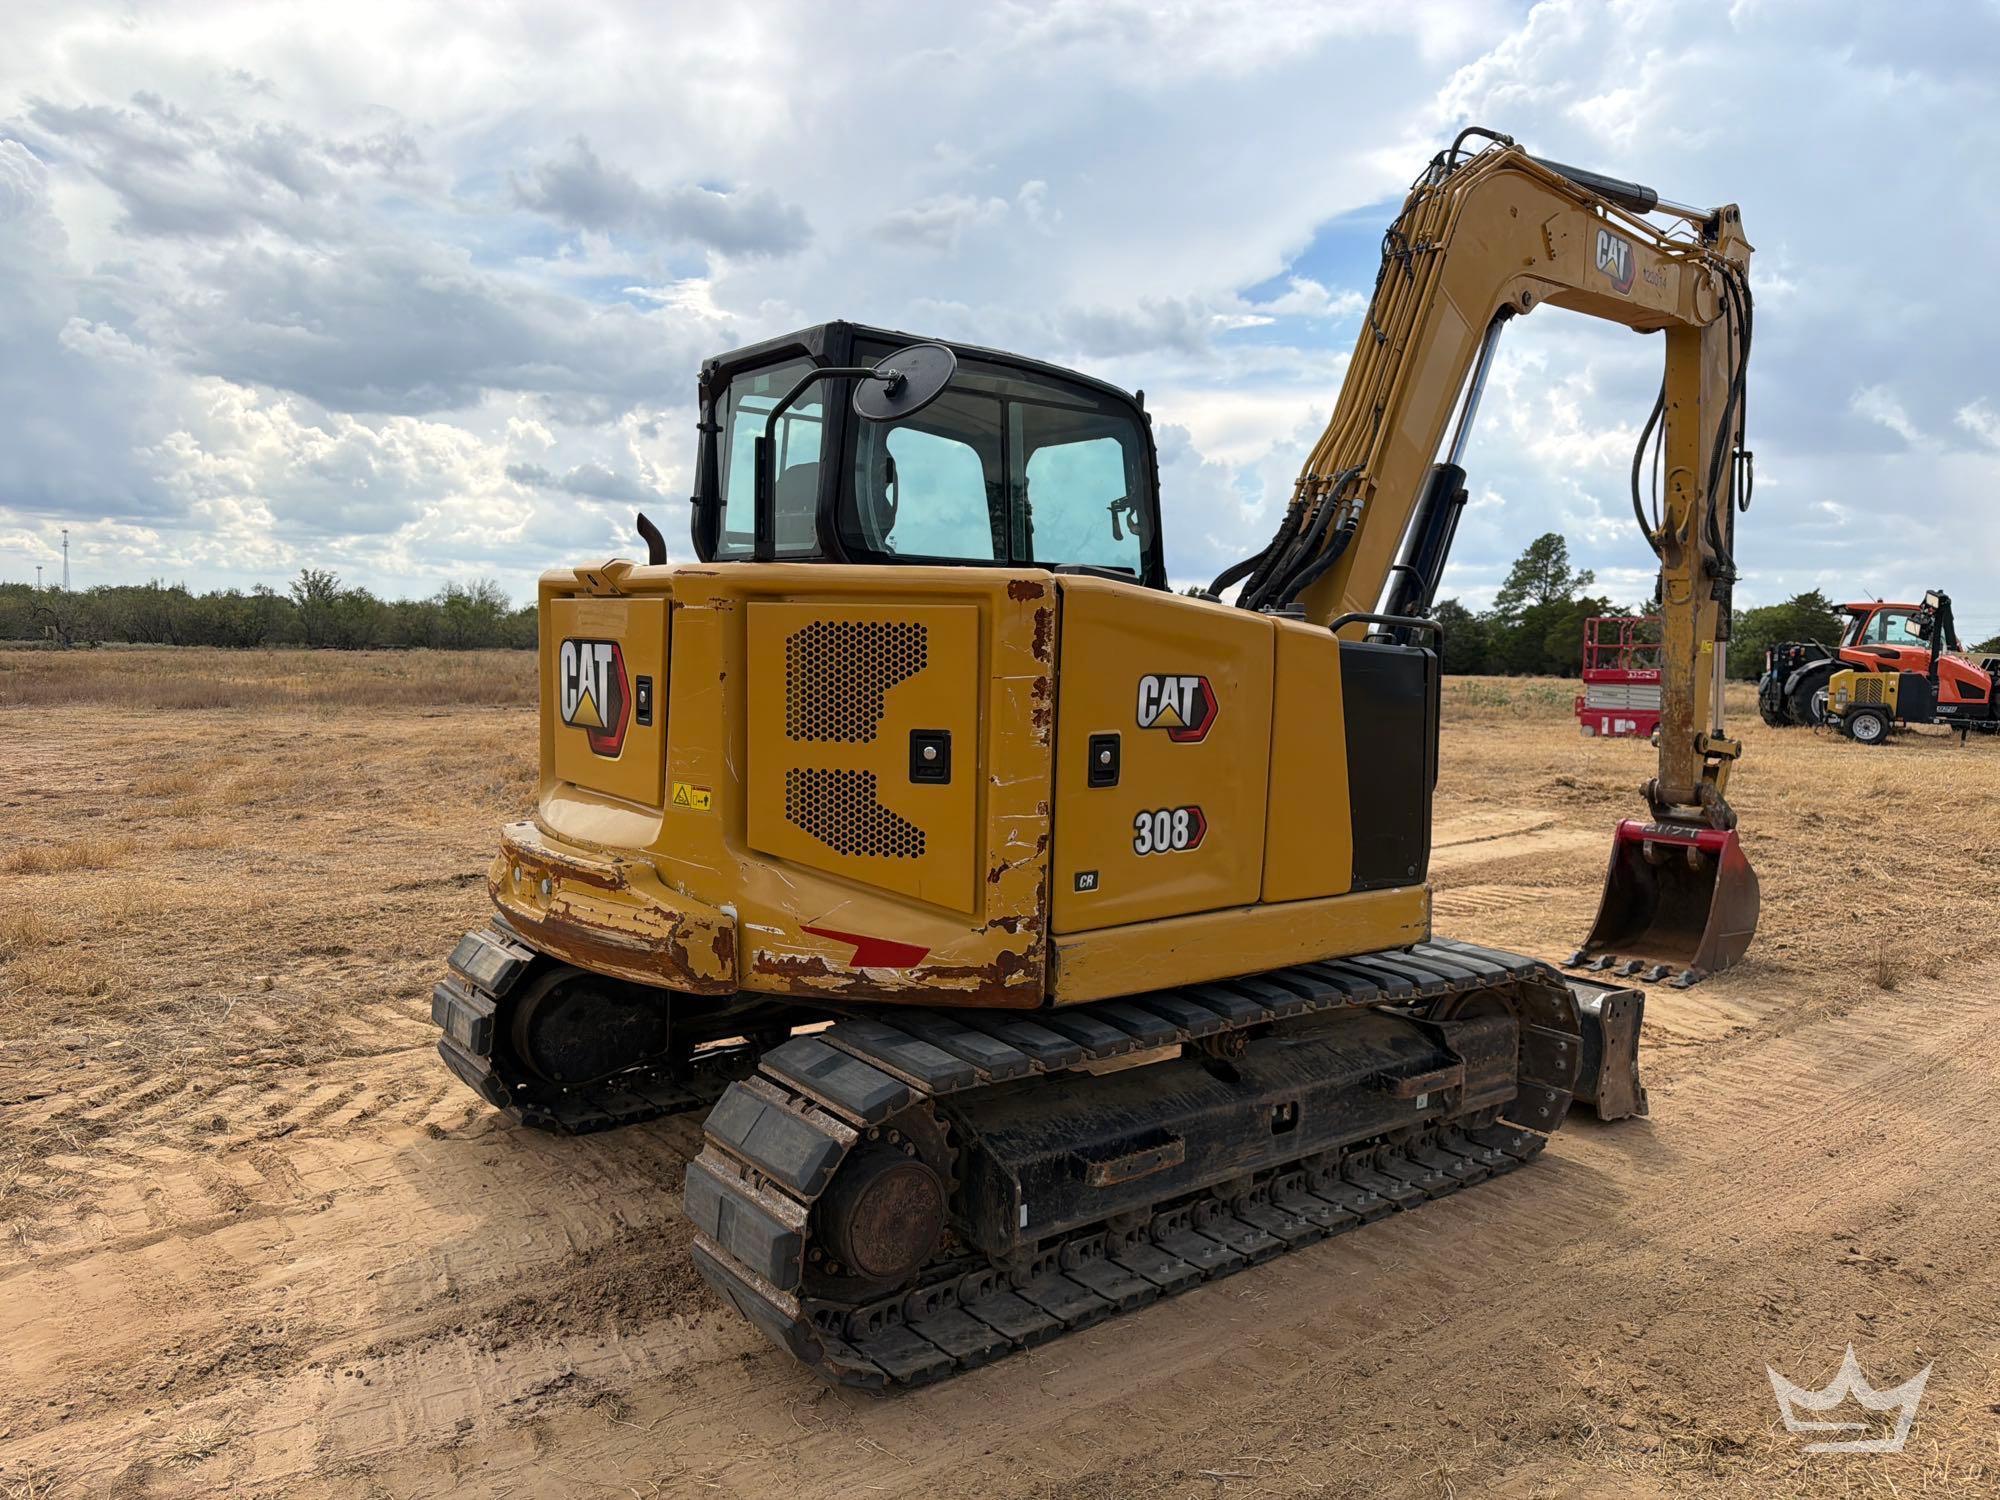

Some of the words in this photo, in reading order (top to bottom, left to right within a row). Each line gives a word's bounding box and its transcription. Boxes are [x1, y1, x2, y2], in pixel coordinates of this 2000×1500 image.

[1597, 230, 1628, 280] CAT
[560, 640, 612, 728] CAT
[1138, 675, 1198, 728] CAT
[1135, 809, 1189, 854] 308
[1079, 875, 1094, 888] CR
